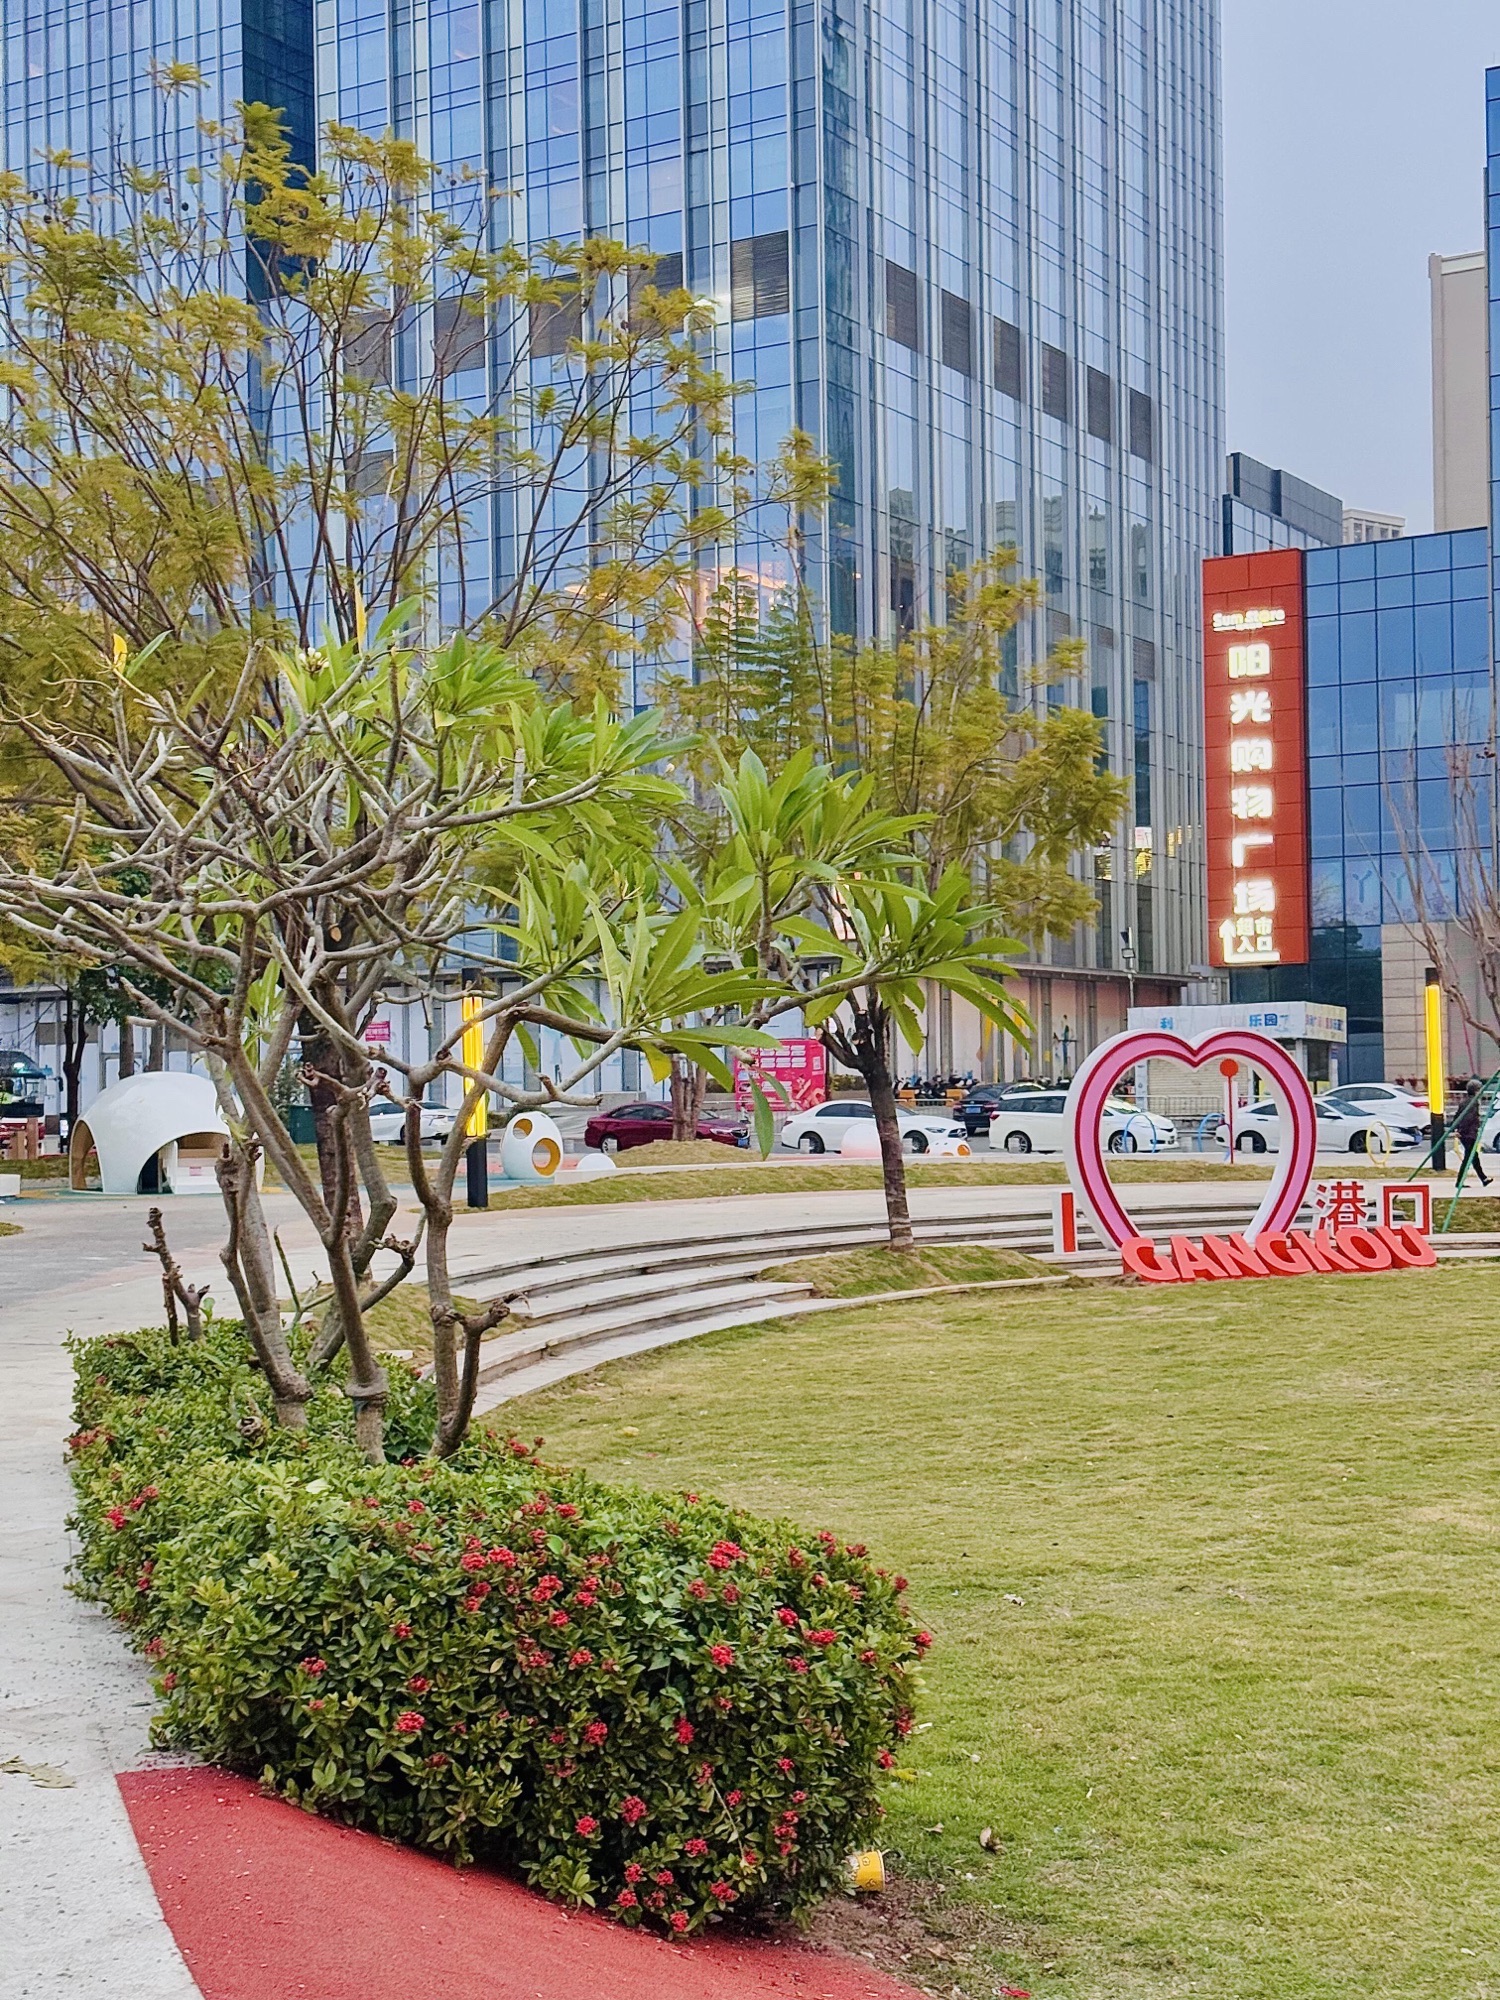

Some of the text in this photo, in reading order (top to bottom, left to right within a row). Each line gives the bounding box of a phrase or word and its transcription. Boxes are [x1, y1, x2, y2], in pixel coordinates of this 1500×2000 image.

[1227, 642, 1276, 915] 阳光购物广场
[1236, 916, 1273, 936] 超市
[1236, 936, 1273, 953] 入口
[1315, 1180, 1431, 1236] 港口
[1121, 1224, 1437, 1282] GANGKOU
